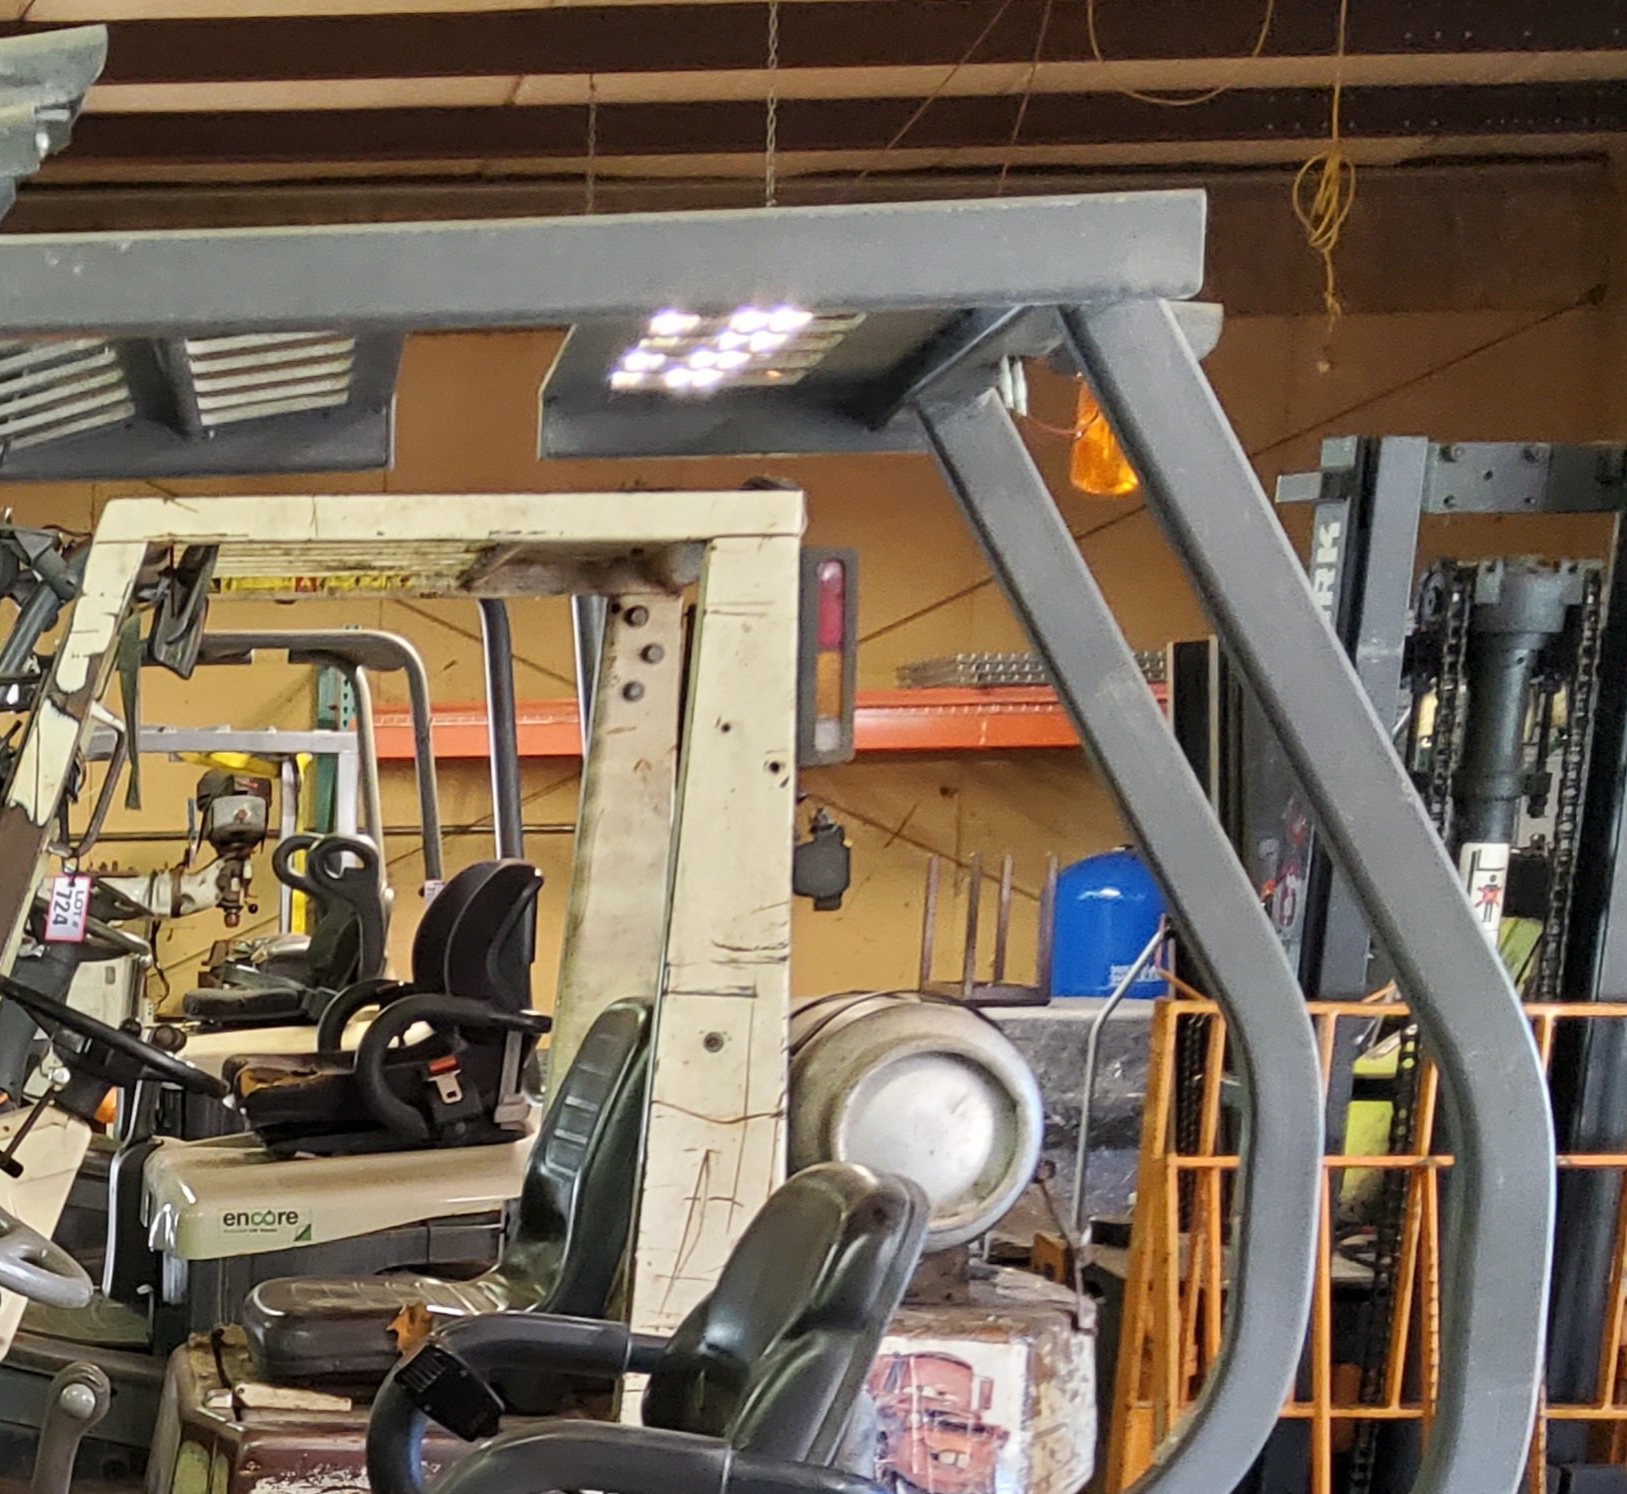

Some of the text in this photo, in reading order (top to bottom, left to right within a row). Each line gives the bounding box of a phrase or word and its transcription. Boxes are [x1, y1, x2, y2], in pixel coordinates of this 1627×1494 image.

[52, 890, 72, 925] 724
[73, 891, 85, 918] LOT
[223, 1209, 298, 1227] encore
